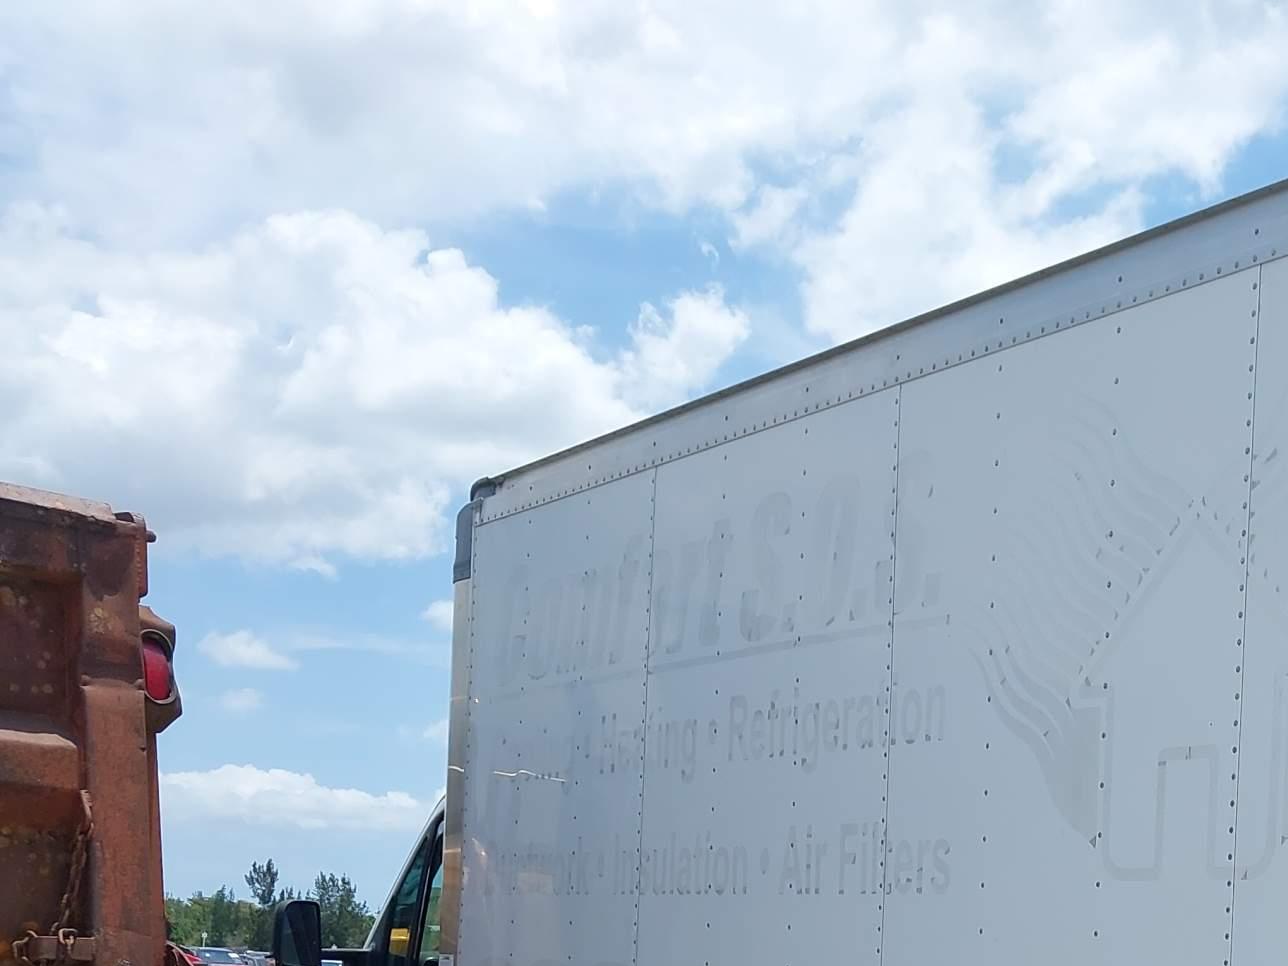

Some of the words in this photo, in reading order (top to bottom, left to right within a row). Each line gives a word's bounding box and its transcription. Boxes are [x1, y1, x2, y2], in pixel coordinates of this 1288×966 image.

[728, 684, 947, 773] Refrigeration
[779, 825, 829, 896] Air
[838, 822, 951, 896] Filters
